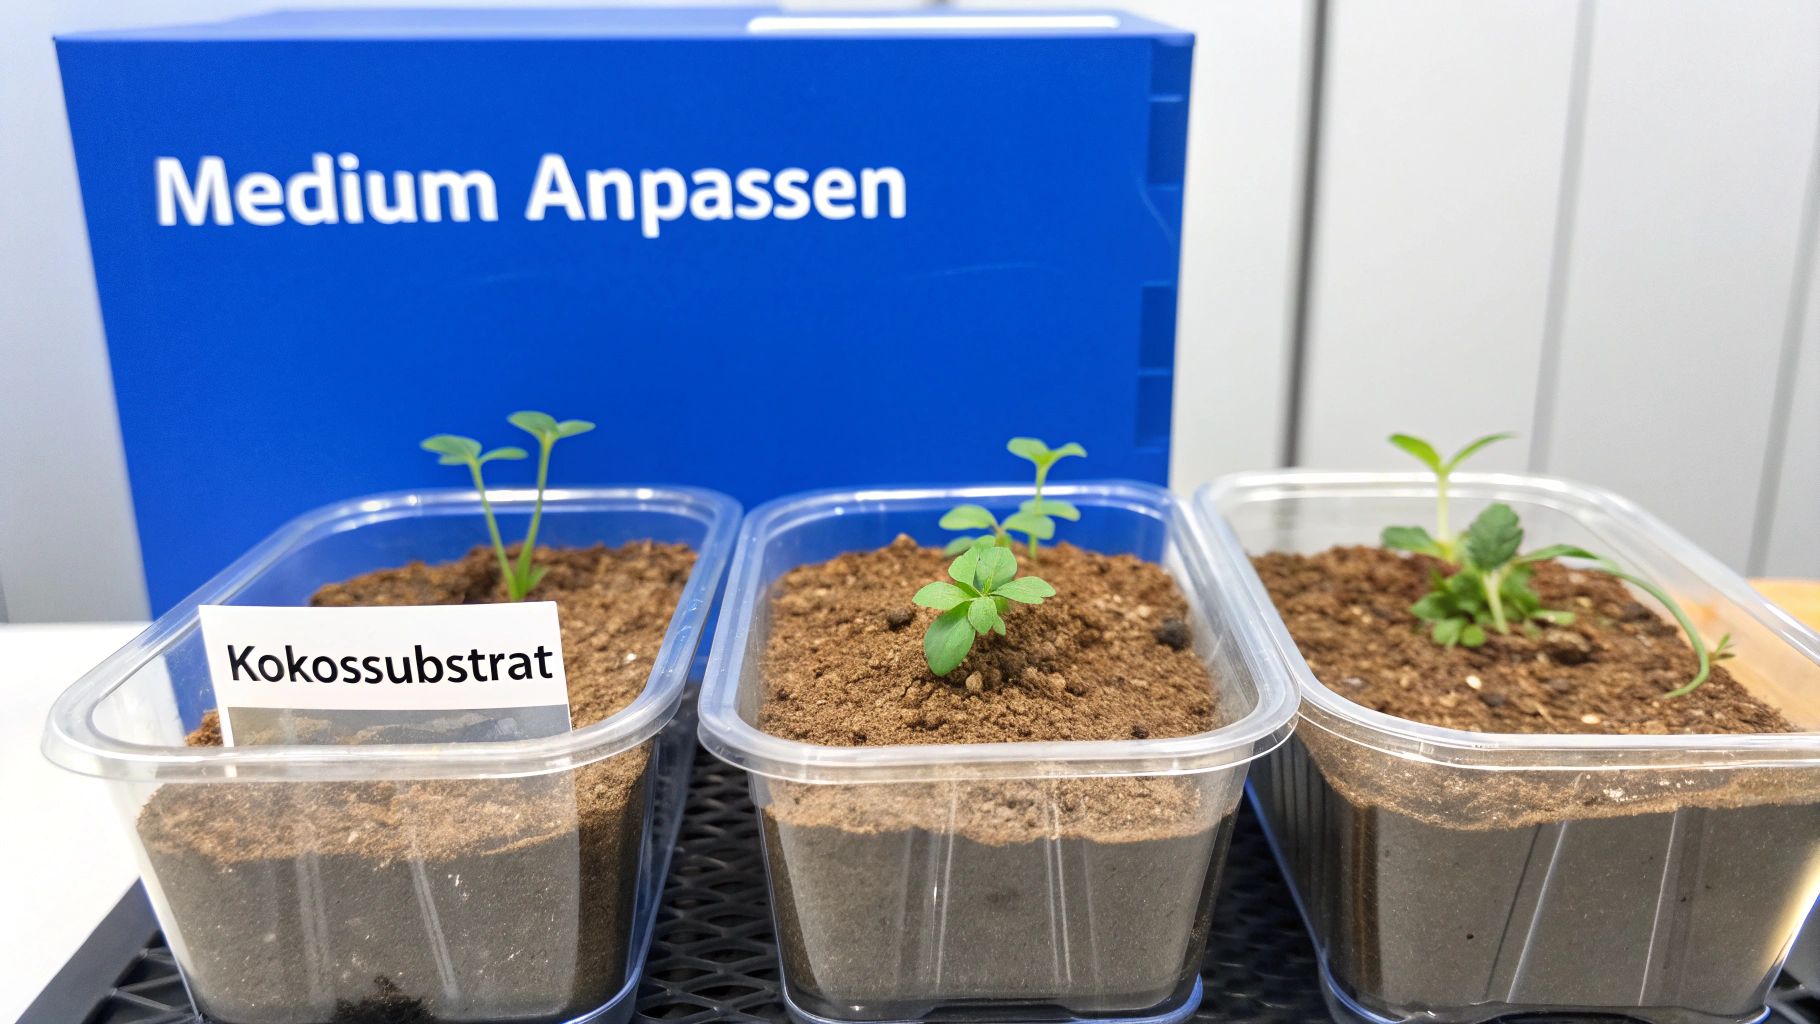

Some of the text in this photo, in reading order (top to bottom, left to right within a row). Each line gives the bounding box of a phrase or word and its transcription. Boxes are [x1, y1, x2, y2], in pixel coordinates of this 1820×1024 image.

[155, 152, 907, 239] Medium Anpassen
[226, 643, 554, 685] Kokossubstrat
